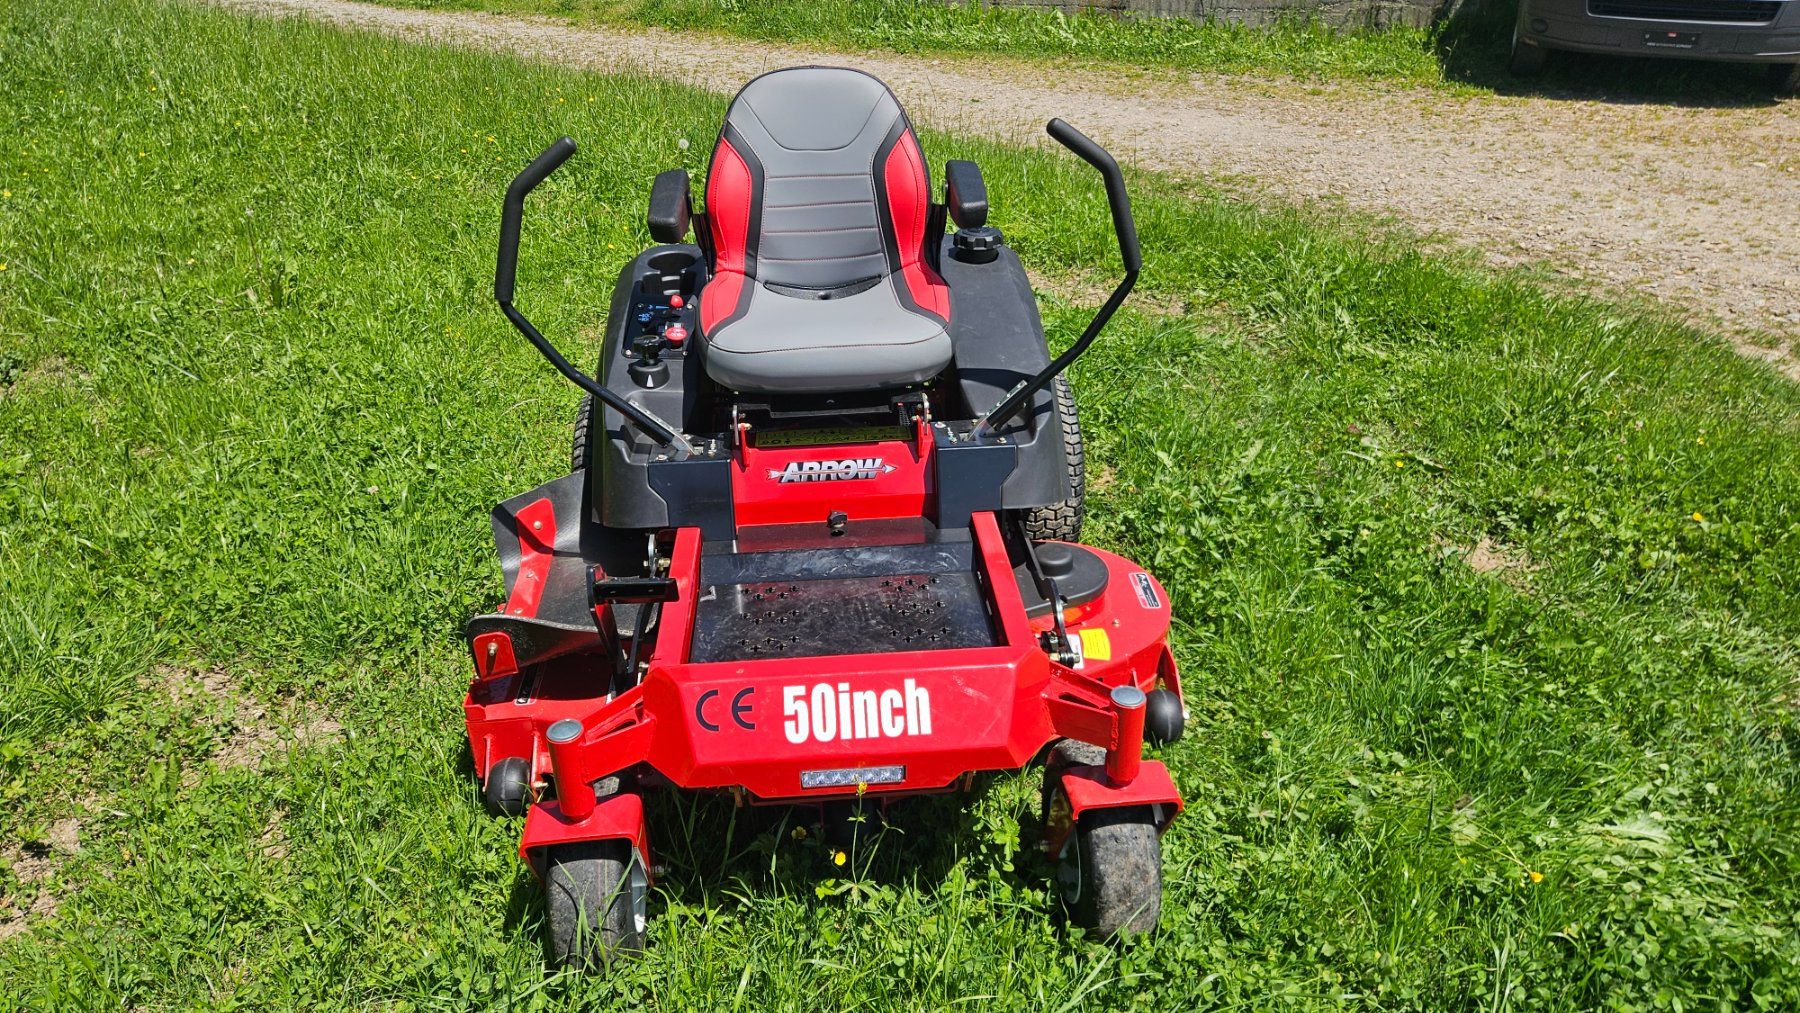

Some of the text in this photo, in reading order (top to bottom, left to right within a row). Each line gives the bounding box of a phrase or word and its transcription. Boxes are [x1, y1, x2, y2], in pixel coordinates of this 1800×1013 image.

[781, 458, 883, 484] ARROW
[695, 678, 932, 744] CE 50inch
